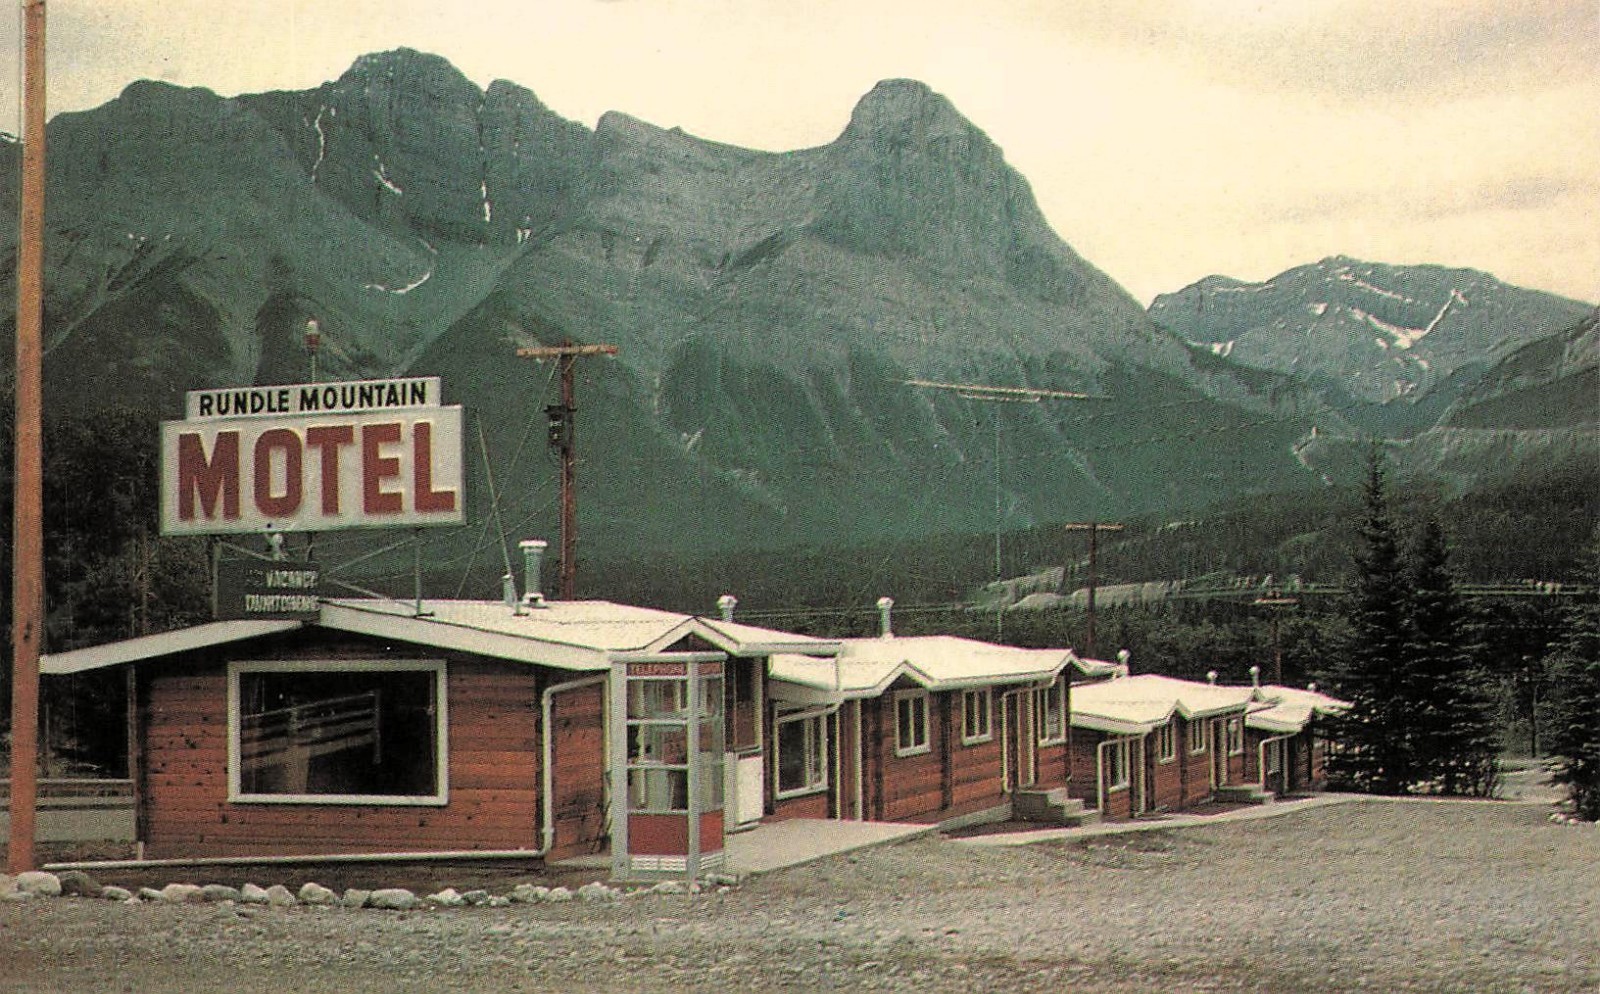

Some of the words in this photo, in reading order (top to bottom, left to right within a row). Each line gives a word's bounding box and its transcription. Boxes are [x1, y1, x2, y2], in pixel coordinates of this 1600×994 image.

[200, 390, 289, 416] RUNDLE
[300, 381, 427, 410] MOUNTAIN
[178, 421, 456, 522] MOTEL
